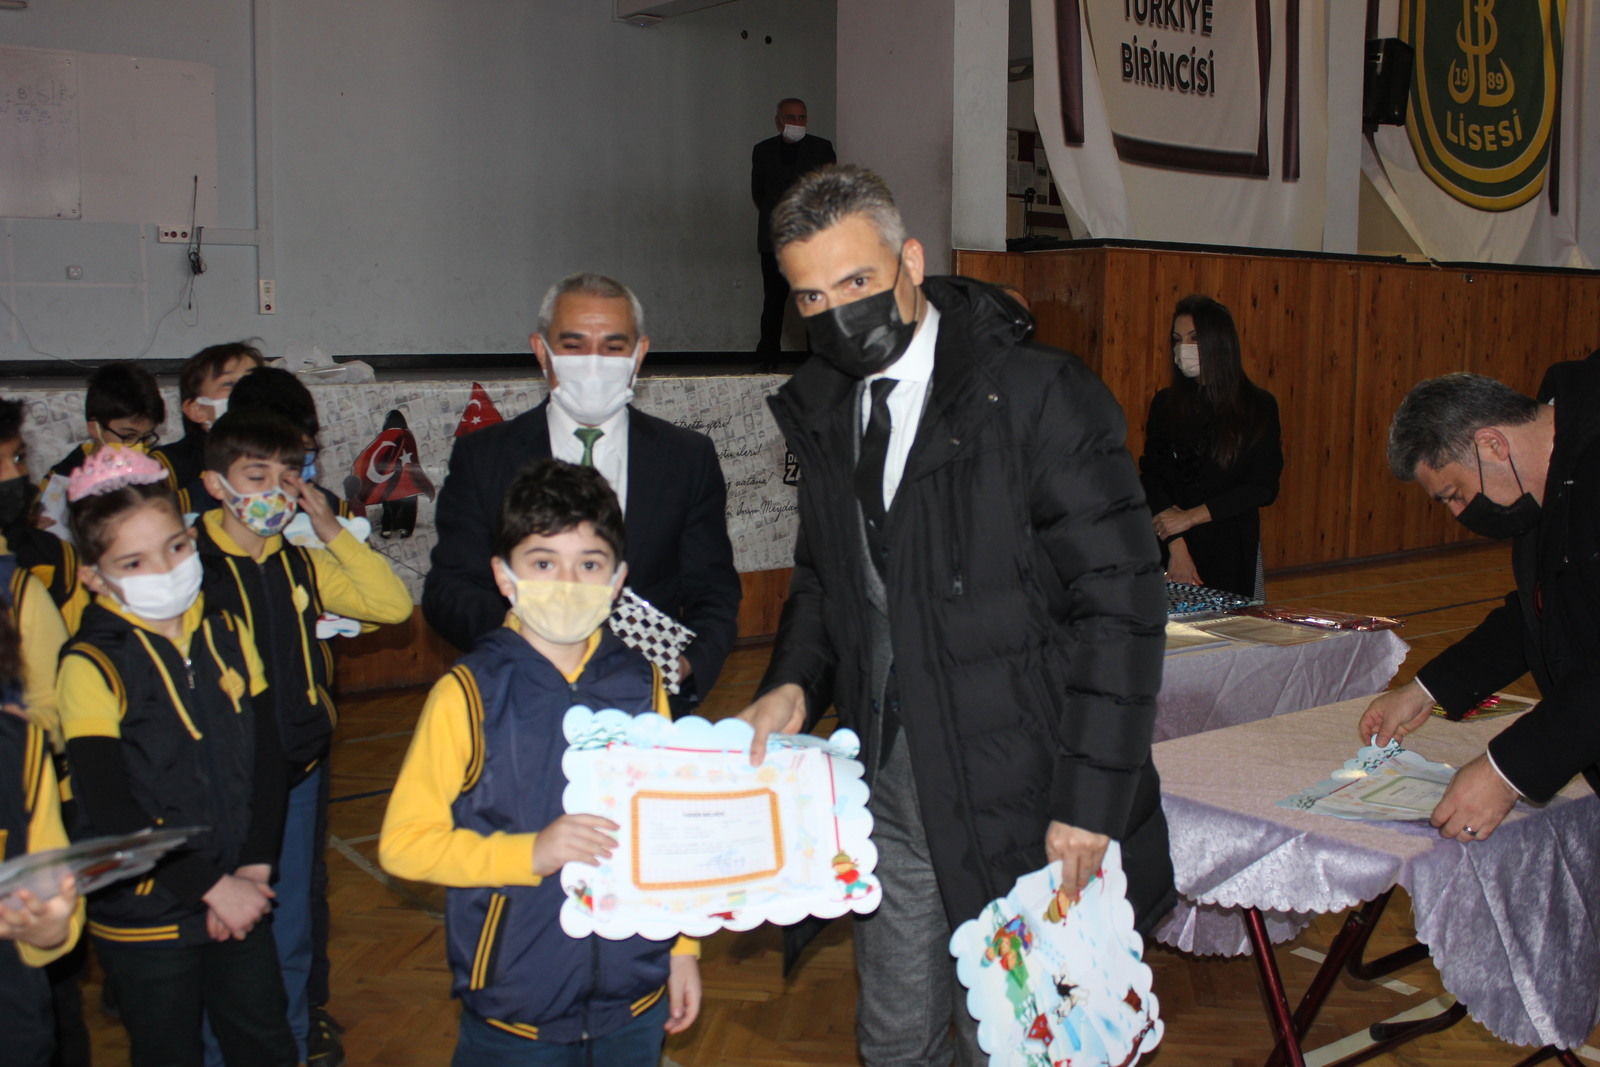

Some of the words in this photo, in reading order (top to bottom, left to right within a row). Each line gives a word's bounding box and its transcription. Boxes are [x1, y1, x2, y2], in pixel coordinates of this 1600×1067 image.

[1121, 35, 1215, 96] BİRİNCİSİ
[1454, 67, 1469, 87] 19
[1446, 108, 1523, 152] LİSESİ
